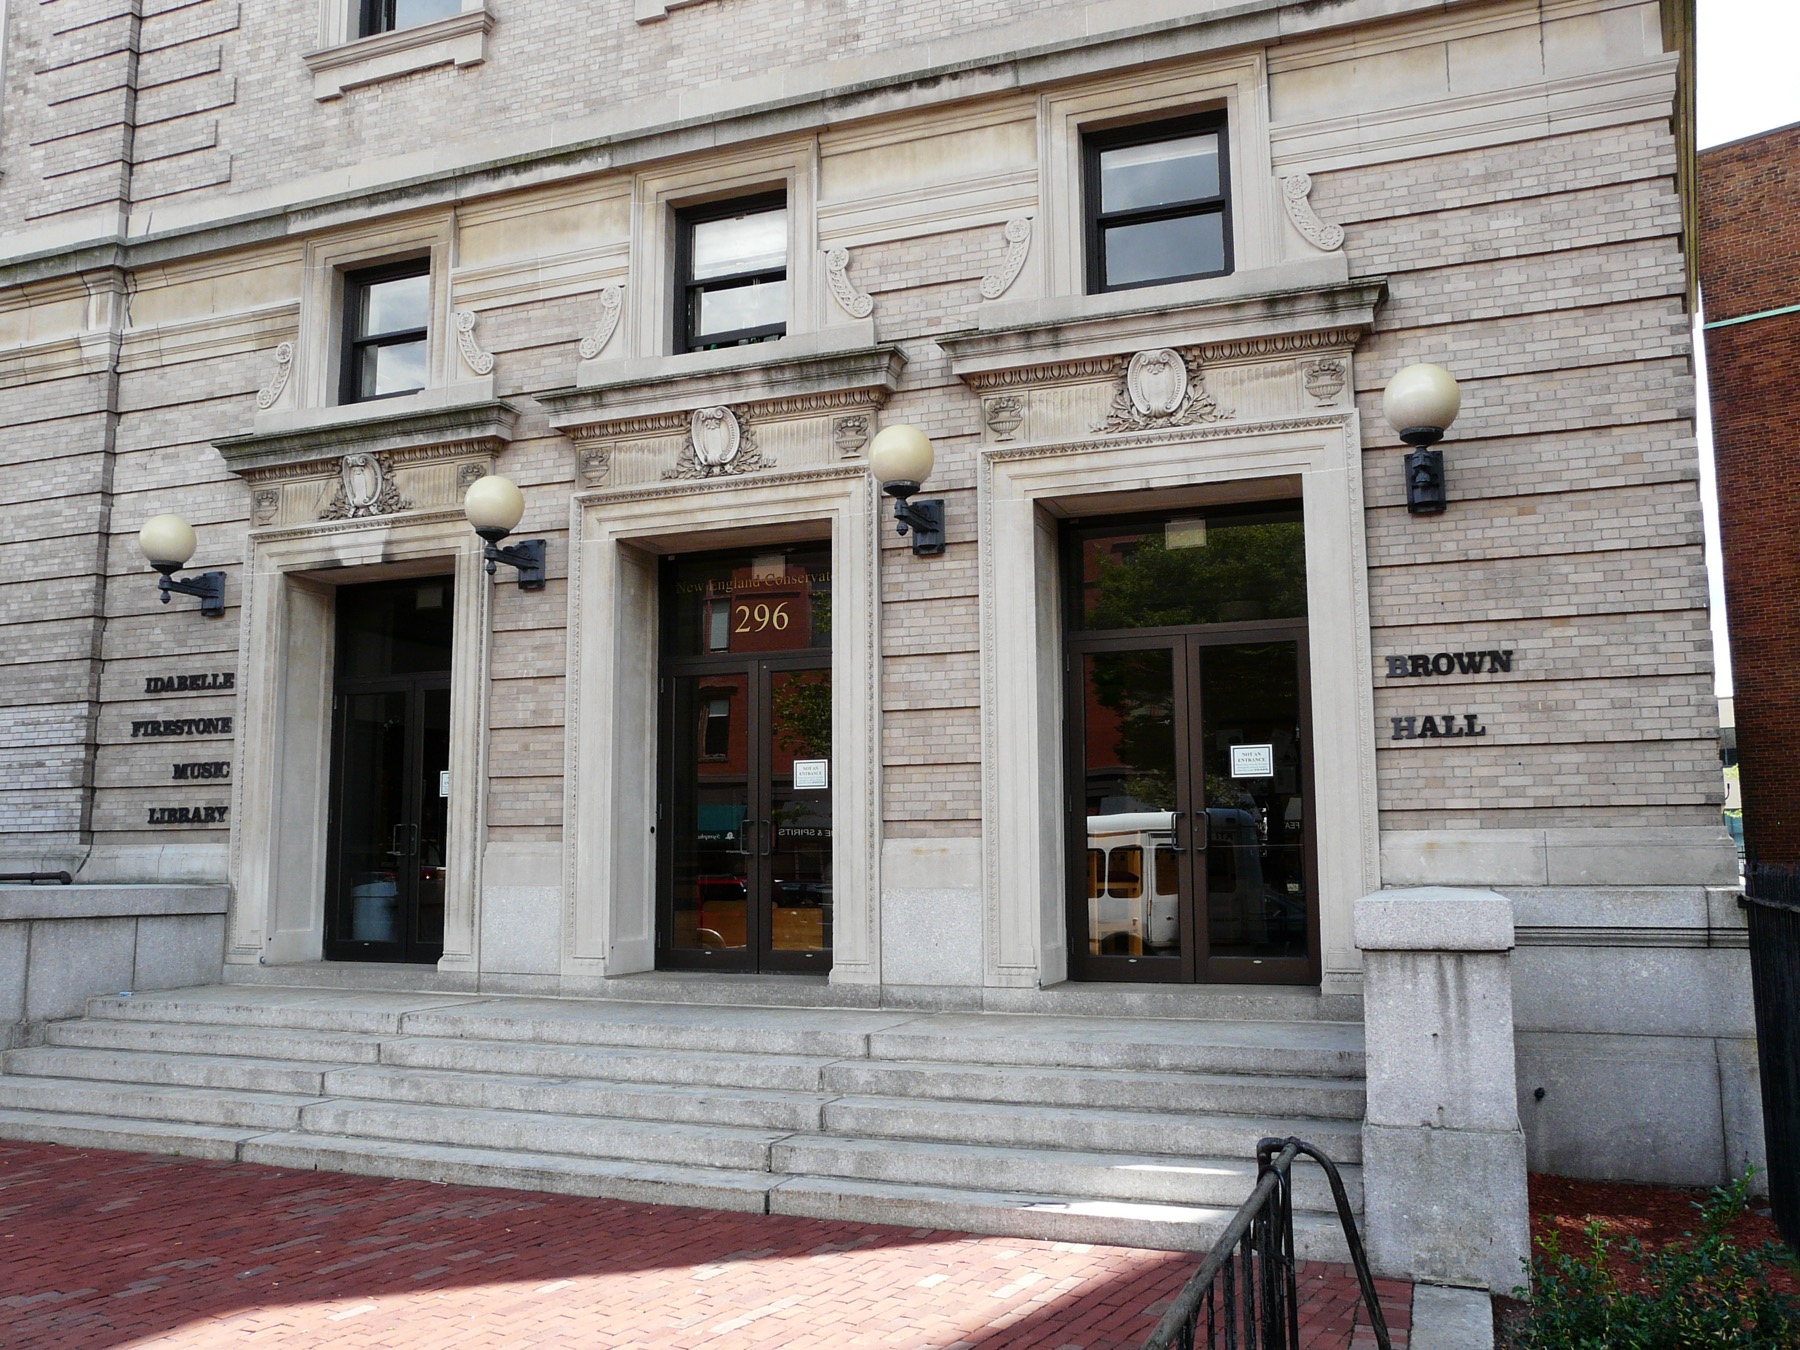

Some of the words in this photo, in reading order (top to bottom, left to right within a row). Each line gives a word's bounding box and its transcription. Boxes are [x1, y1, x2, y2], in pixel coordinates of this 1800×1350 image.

[676, 581, 704, 594] New
[709, 574, 761, 593] England
[764, 570, 833, 587] Conservat
[734, 601, 790, 633] 296
[1385, 650, 1513, 678] BROWN
[144, 672, 235, 693] IDABELLE
[130, 716, 233, 737] FIRESTONE
[1390, 714, 1486, 740] HALL
[171, 761, 231, 779] MUSIC
[147, 806, 229, 824] LIBRARY
